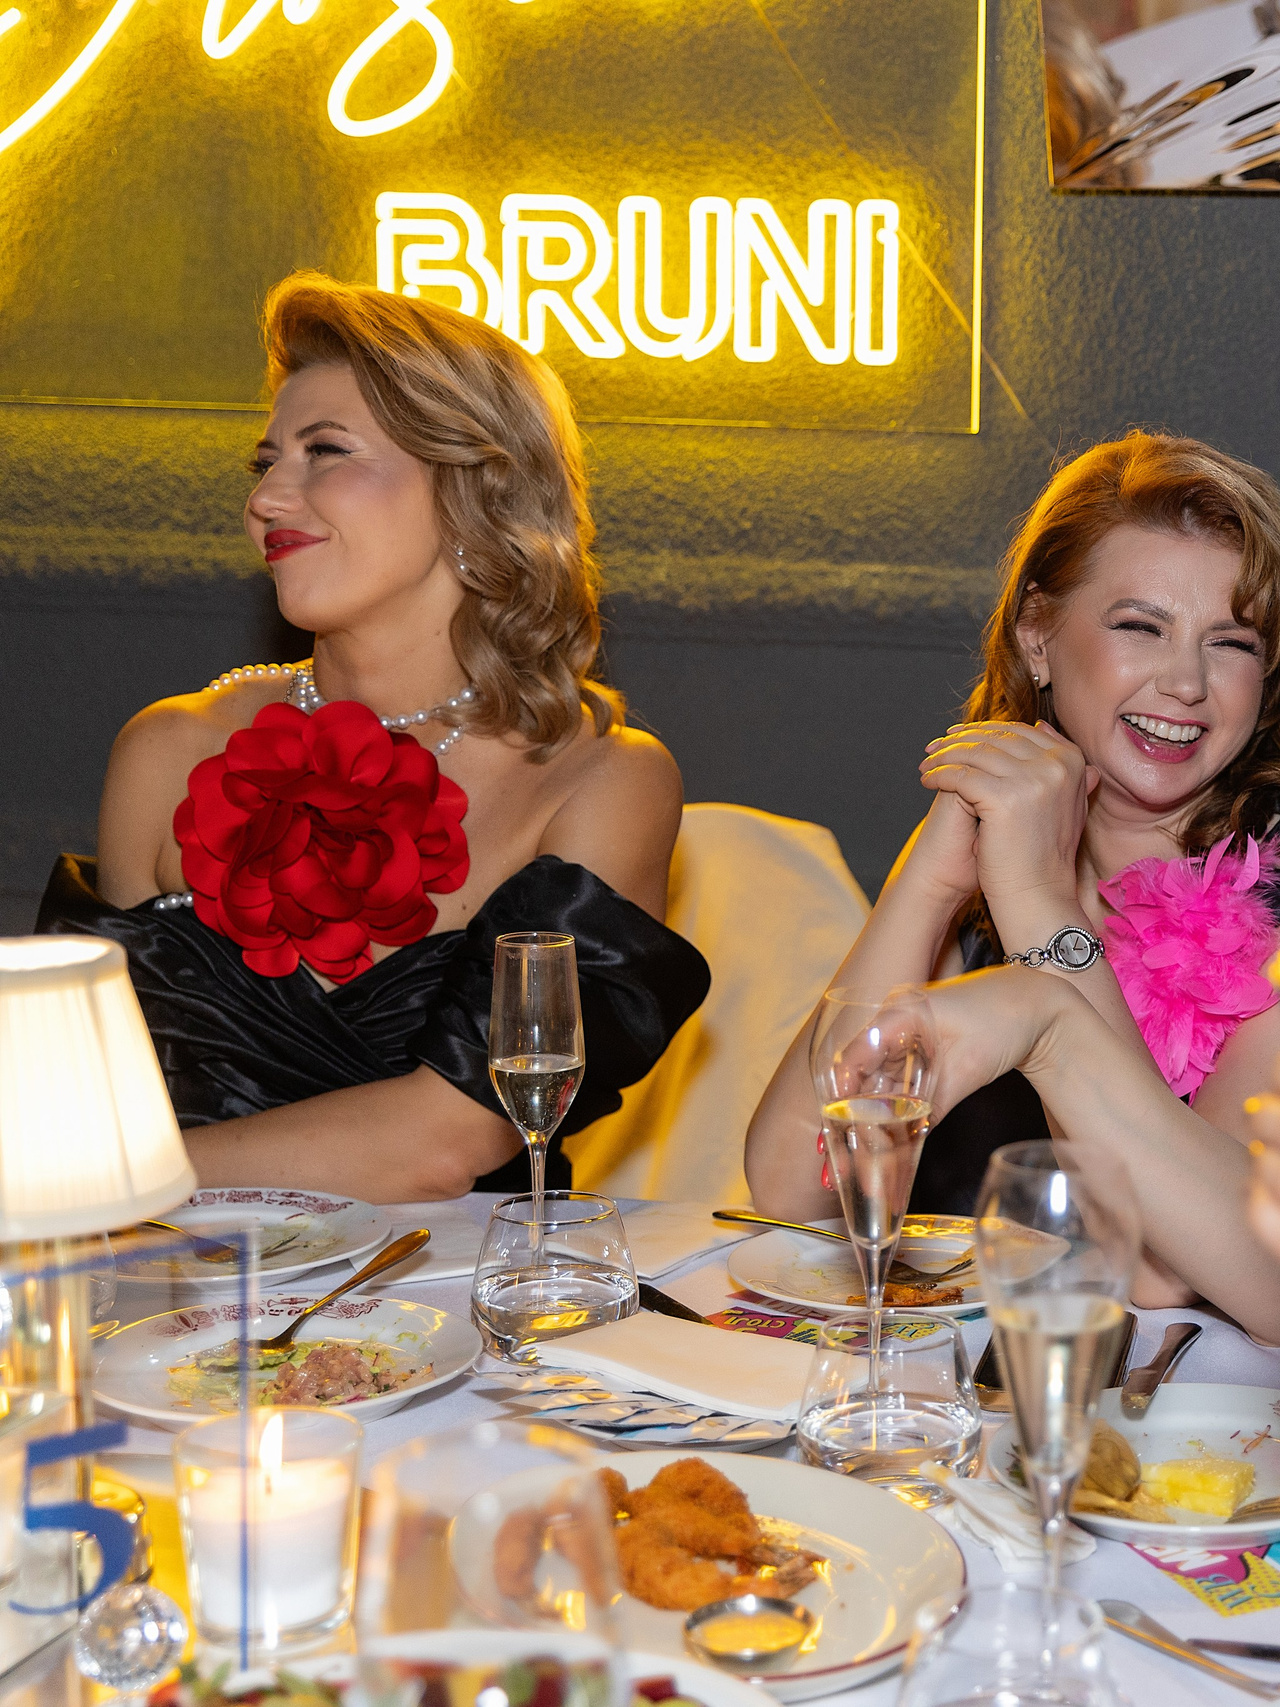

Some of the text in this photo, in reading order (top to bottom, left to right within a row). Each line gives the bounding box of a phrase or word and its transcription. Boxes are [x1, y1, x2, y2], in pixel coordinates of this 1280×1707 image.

[375, 191, 899, 367] BRUNI
[724, 1315, 785, 1330] СТОЛ
[8, 1421, 135, 1617] 5
